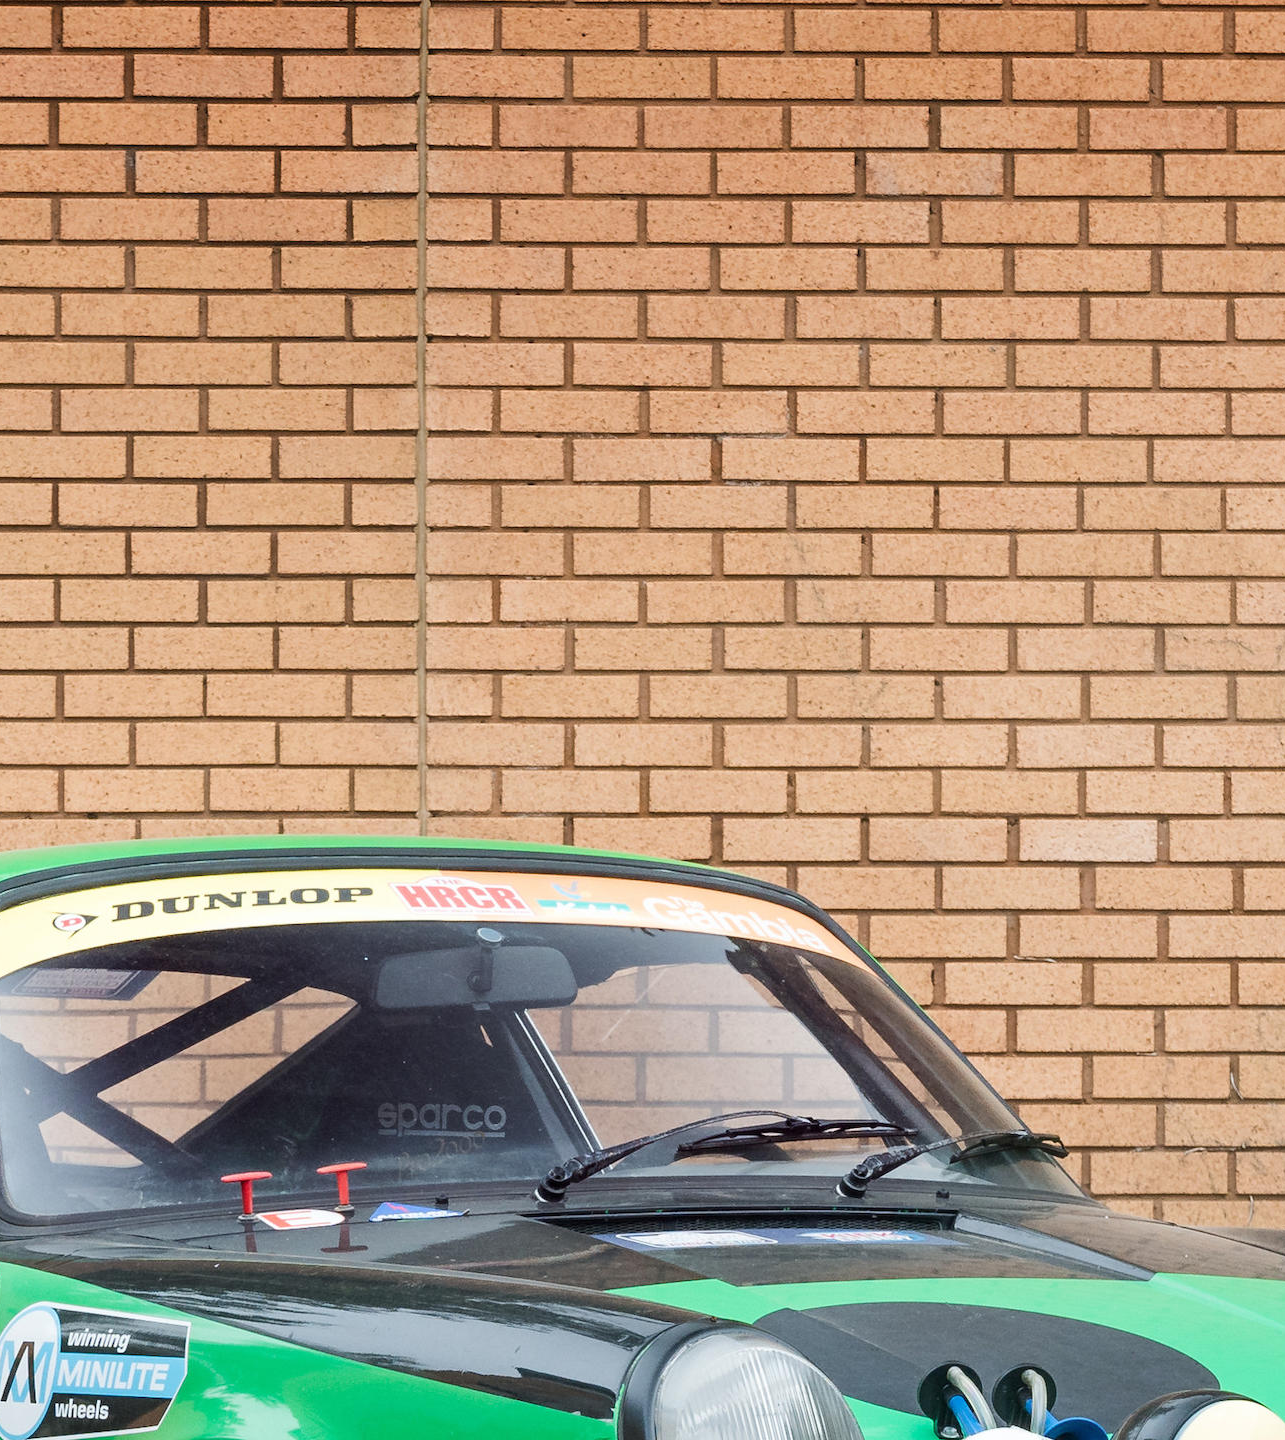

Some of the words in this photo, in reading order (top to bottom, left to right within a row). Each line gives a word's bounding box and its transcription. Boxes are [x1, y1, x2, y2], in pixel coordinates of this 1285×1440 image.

[111, 887, 374, 922] DUNLOP
[395, 885, 527, 910] HRCR
[642, 897, 832, 953] Gambia
[377, 1102, 507, 1137] sparco
[67, 1328, 131, 1353] winning
[56, 1359, 171, 1391] MINILITE
[54, 1398, 110, 1420] wheels
